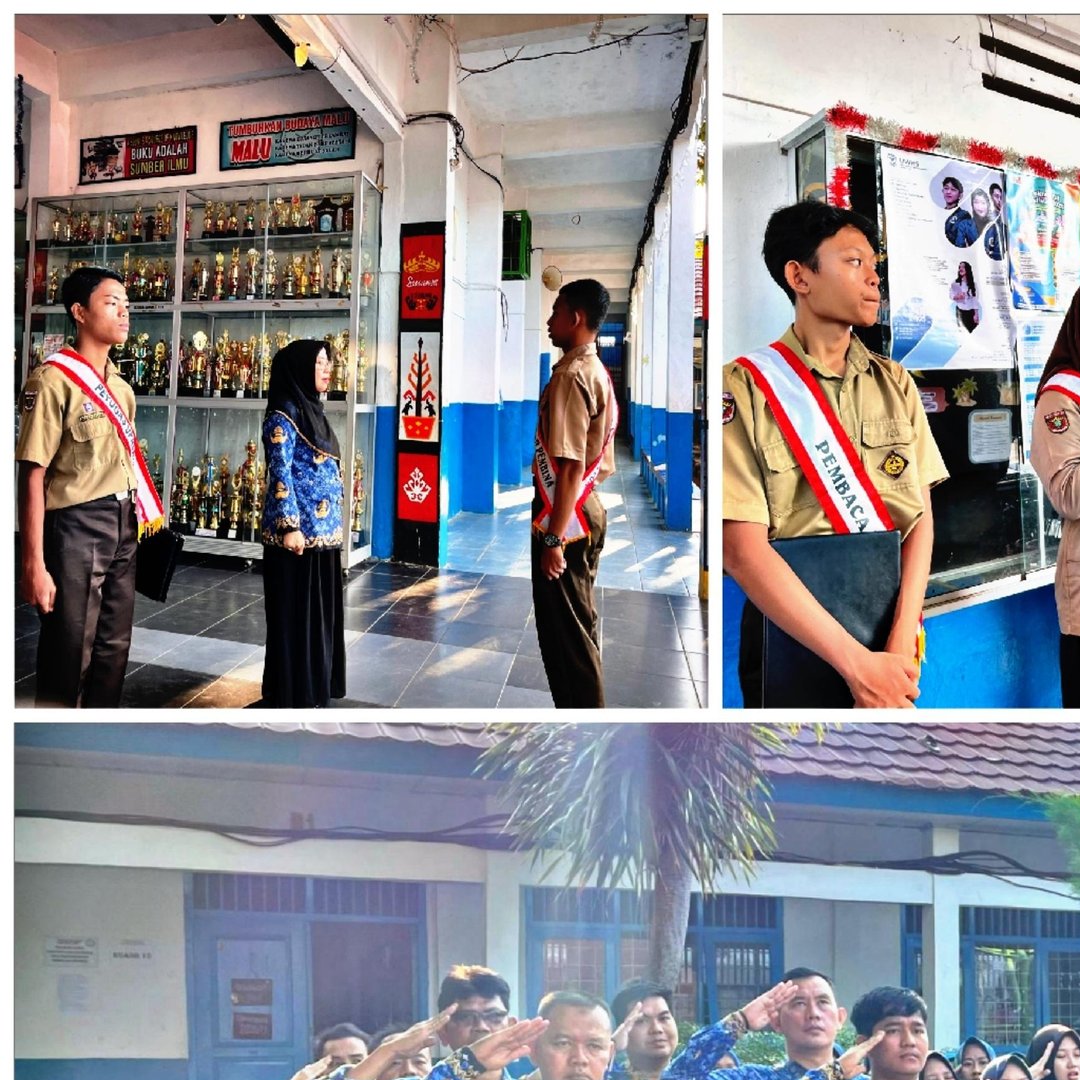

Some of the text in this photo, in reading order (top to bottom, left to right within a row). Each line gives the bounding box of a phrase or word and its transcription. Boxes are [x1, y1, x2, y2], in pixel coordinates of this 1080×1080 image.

[228, 121, 282, 138] TUMBUHKAN
[285, 114, 321, 131] BUDAYA
[323, 111, 350, 127] MALU
[131, 142, 188, 160] BUKU ADALAH
[230, 137, 272, 163] MALU
[130, 157, 189, 176] SUMBER ILMU
[535, 446, 557, 488] PEMBINA
[815, 439, 870, 533] PEMBACA
